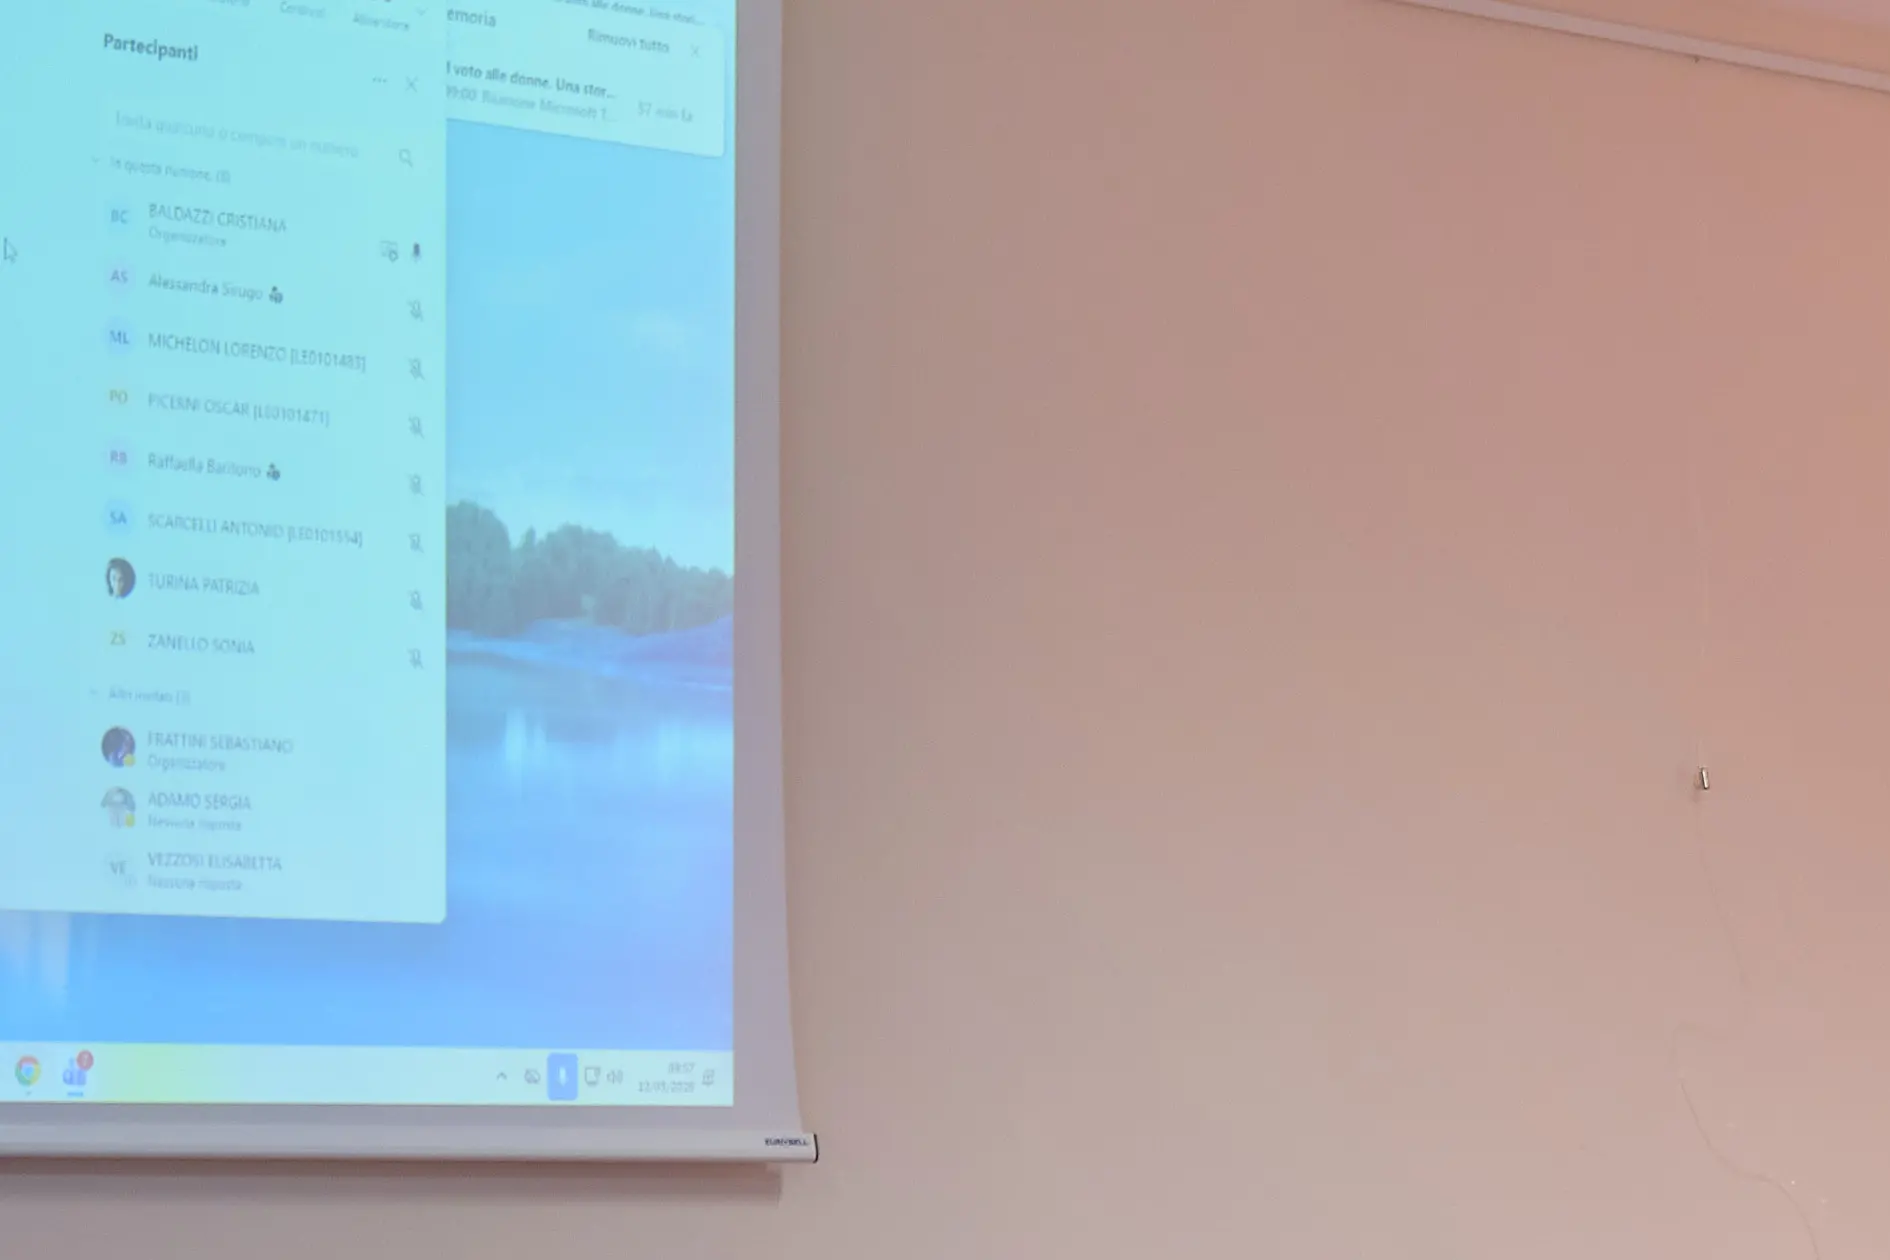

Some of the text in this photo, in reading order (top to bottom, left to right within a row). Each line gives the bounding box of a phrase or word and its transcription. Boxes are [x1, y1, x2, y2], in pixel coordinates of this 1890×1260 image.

[446, 7, 498, 29] emoria
[103, 33, 199, 61] Partecipanti
[587, 27, 670, 54] Rimuovi tutto
[453, 63, 483, 79] voto
[485, 67, 507, 82] alle
[555, 77, 581, 95] Una
[147, 202, 288, 234] BALDAZZI CRISTIANA
[109, 268, 129, 285] AS
[147, 272, 219, 297] Alessandra
[109, 329, 130, 346] ML
[147, 331, 221, 357] MICHELON
[223, 340, 287, 362] LORENZO
[203, 397, 250, 418] OSCAR
[109, 510, 129, 525] SA
[147, 511, 217, 535] SCARCELLI
[220, 519, 286, 540] ANTONIO
[202, 576, 260, 597] PATRIZIA
[147, 632, 256, 655] ZANELLO SONIA
[209, 733, 295, 756] SEBASTIANO
[147, 791, 253, 812] ADAMO SERGIA
[207, 853, 284, 873] ELISABETTA
